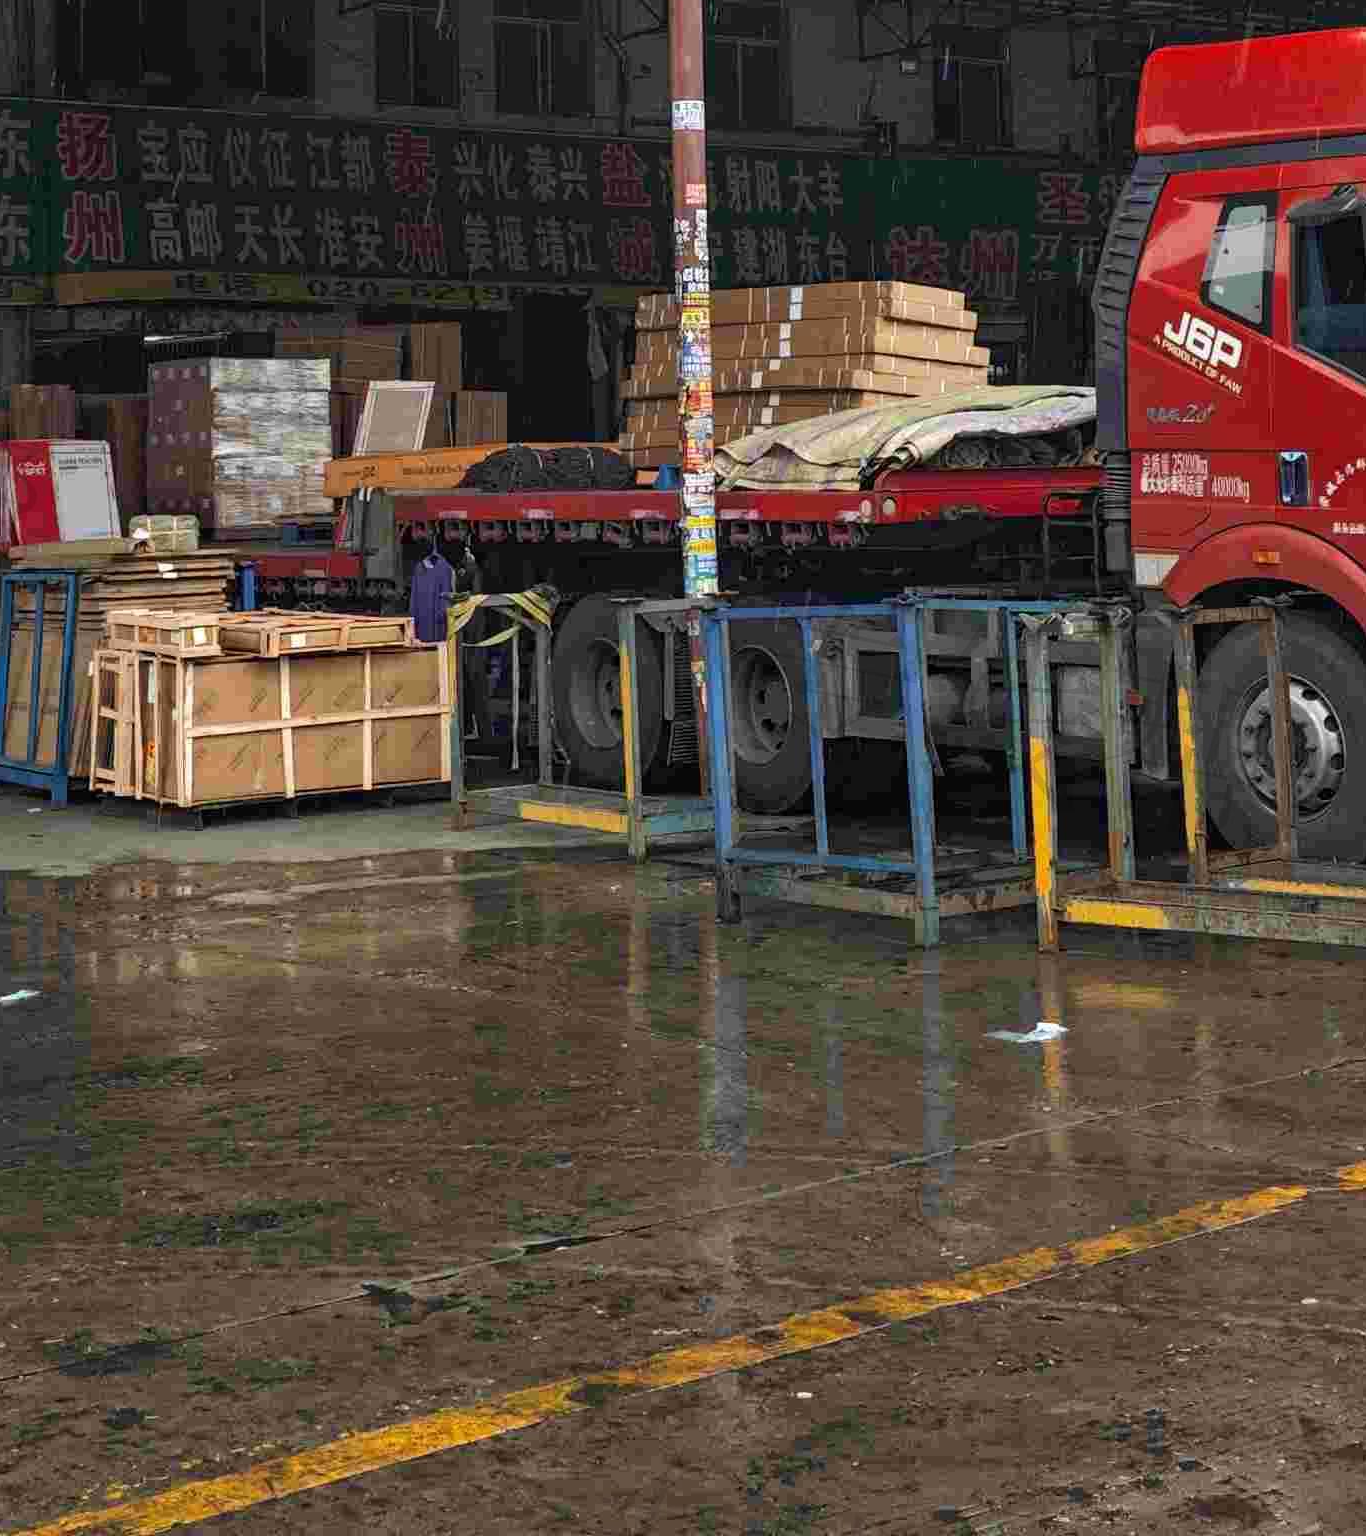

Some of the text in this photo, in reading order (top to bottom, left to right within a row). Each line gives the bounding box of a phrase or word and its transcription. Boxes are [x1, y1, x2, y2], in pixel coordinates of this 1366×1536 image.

[136, 119, 215, 186] 宝应
[56, 110, 127, 265] 扬州
[146, 199, 223, 265] 高邮
[235, 203, 306, 267] 天长
[1163, 311, 1243, 369] J6P
